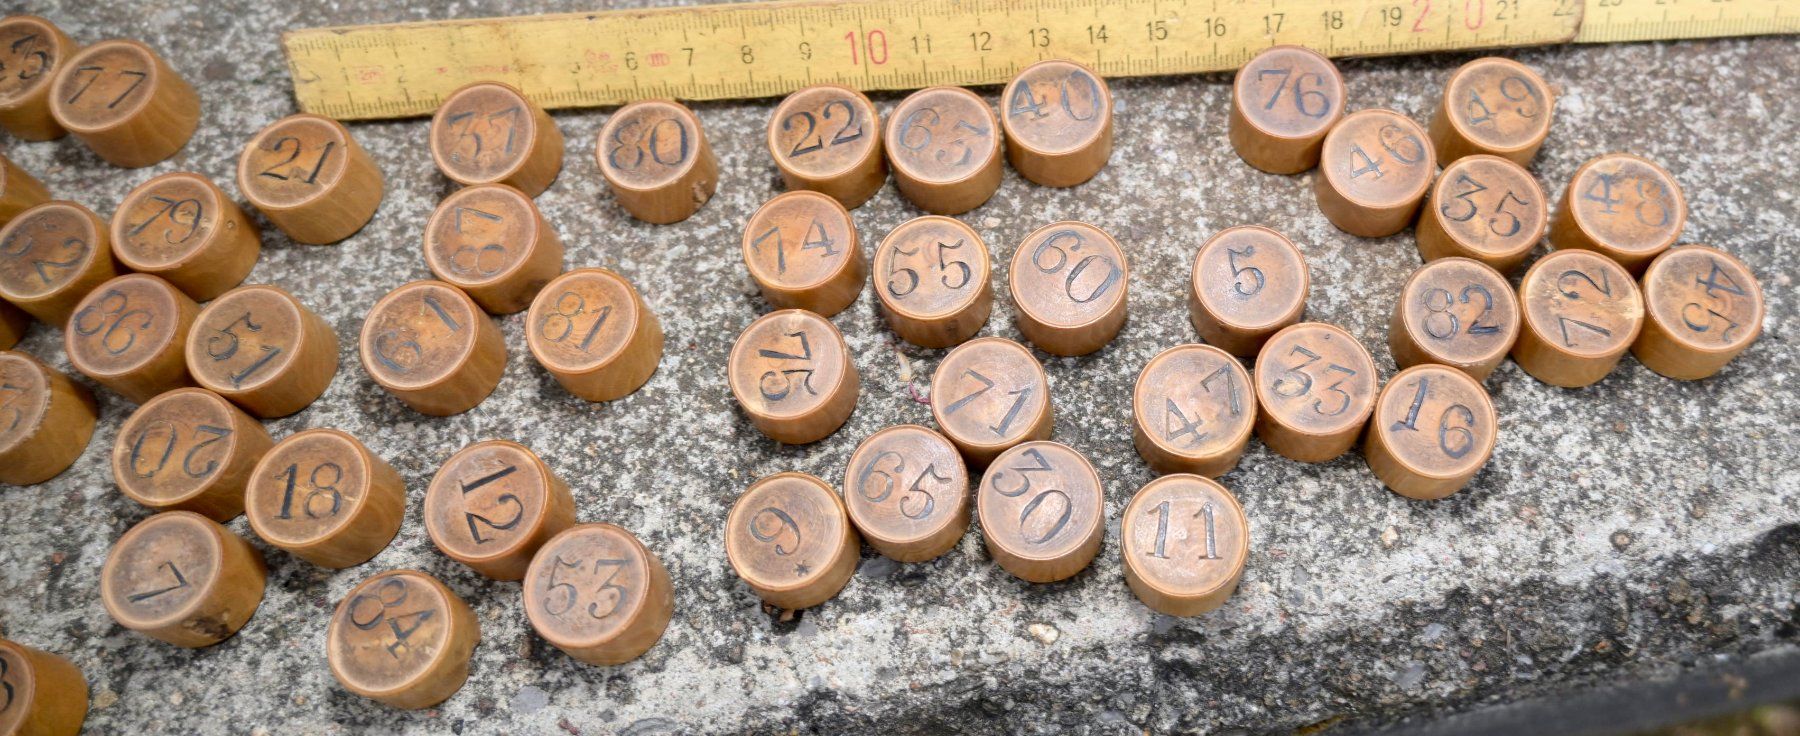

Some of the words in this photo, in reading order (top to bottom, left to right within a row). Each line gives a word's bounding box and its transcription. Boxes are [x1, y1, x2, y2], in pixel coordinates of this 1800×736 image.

[625, 51, 639, 71] 6
[681, 47, 693, 66] 7
[740, 45, 754, 64] 8
[799, 41, 811, 60] 9
[844, 29, 888, 65] 10
[910, 34, 932, 54] 11
[969, 31, 992, 51] 12
[1028, 28, 1051, 47] 13
[1087, 24, 1108, 44] 14
[1146, 20, 1168, 40] 15
[1204, 17, 1227, 37] 16
[1263, 13, 1284, 34] 17
[1321, 10, 1344, 31] 18
[1380, 6, 1402, 27] 19
[68, 66, 147, 109] 77
[1008, 70, 1100, 121] 40
[1258, 69, 1330, 118] 76
[1468, 76, 1538, 127] 49
[259, 136, 337, 185] 21
[447, 106, 521, 163] 37
[608, 118, 688, 170] 80
[783, 100, 864, 158] 22
[1350, 124, 1427, 180] 46
[130, 196, 202, 245] 79
[1440, 173, 1528, 238] 35
[450, 206, 506, 278] 87
[750, 217, 840, 275] 74
[887, 238, 972, 299] 55
[1032, 229, 1123, 304] 60
[1226, 245, 1266, 297] 5
[73, 289, 154, 356] 86
[541, 291, 613, 354] 81
[1423, 284, 1501, 340] 82
[1556, 268, 1613, 347] 72
[1681, 258, 1745, 343] 45
[207, 311, 284, 391] 51
[758, 330, 818, 401] 75
[1271, 344, 1357, 416] 33
[942, 367, 1034, 437] 71
[1164, 362, 1242, 443] 47
[1389, 376, 1475, 461] 16
[130, 420, 234, 479] 20
[273, 462, 344, 520] 18
[458, 460, 529, 545] 12
[857, 450, 953, 520] 65
[992, 447, 1073, 545] 30
[1145, 500, 1224, 560] 11
[126, 559, 191, 603] 7
[543, 554, 632, 621] 53
[347, 577, 438, 661] 84
